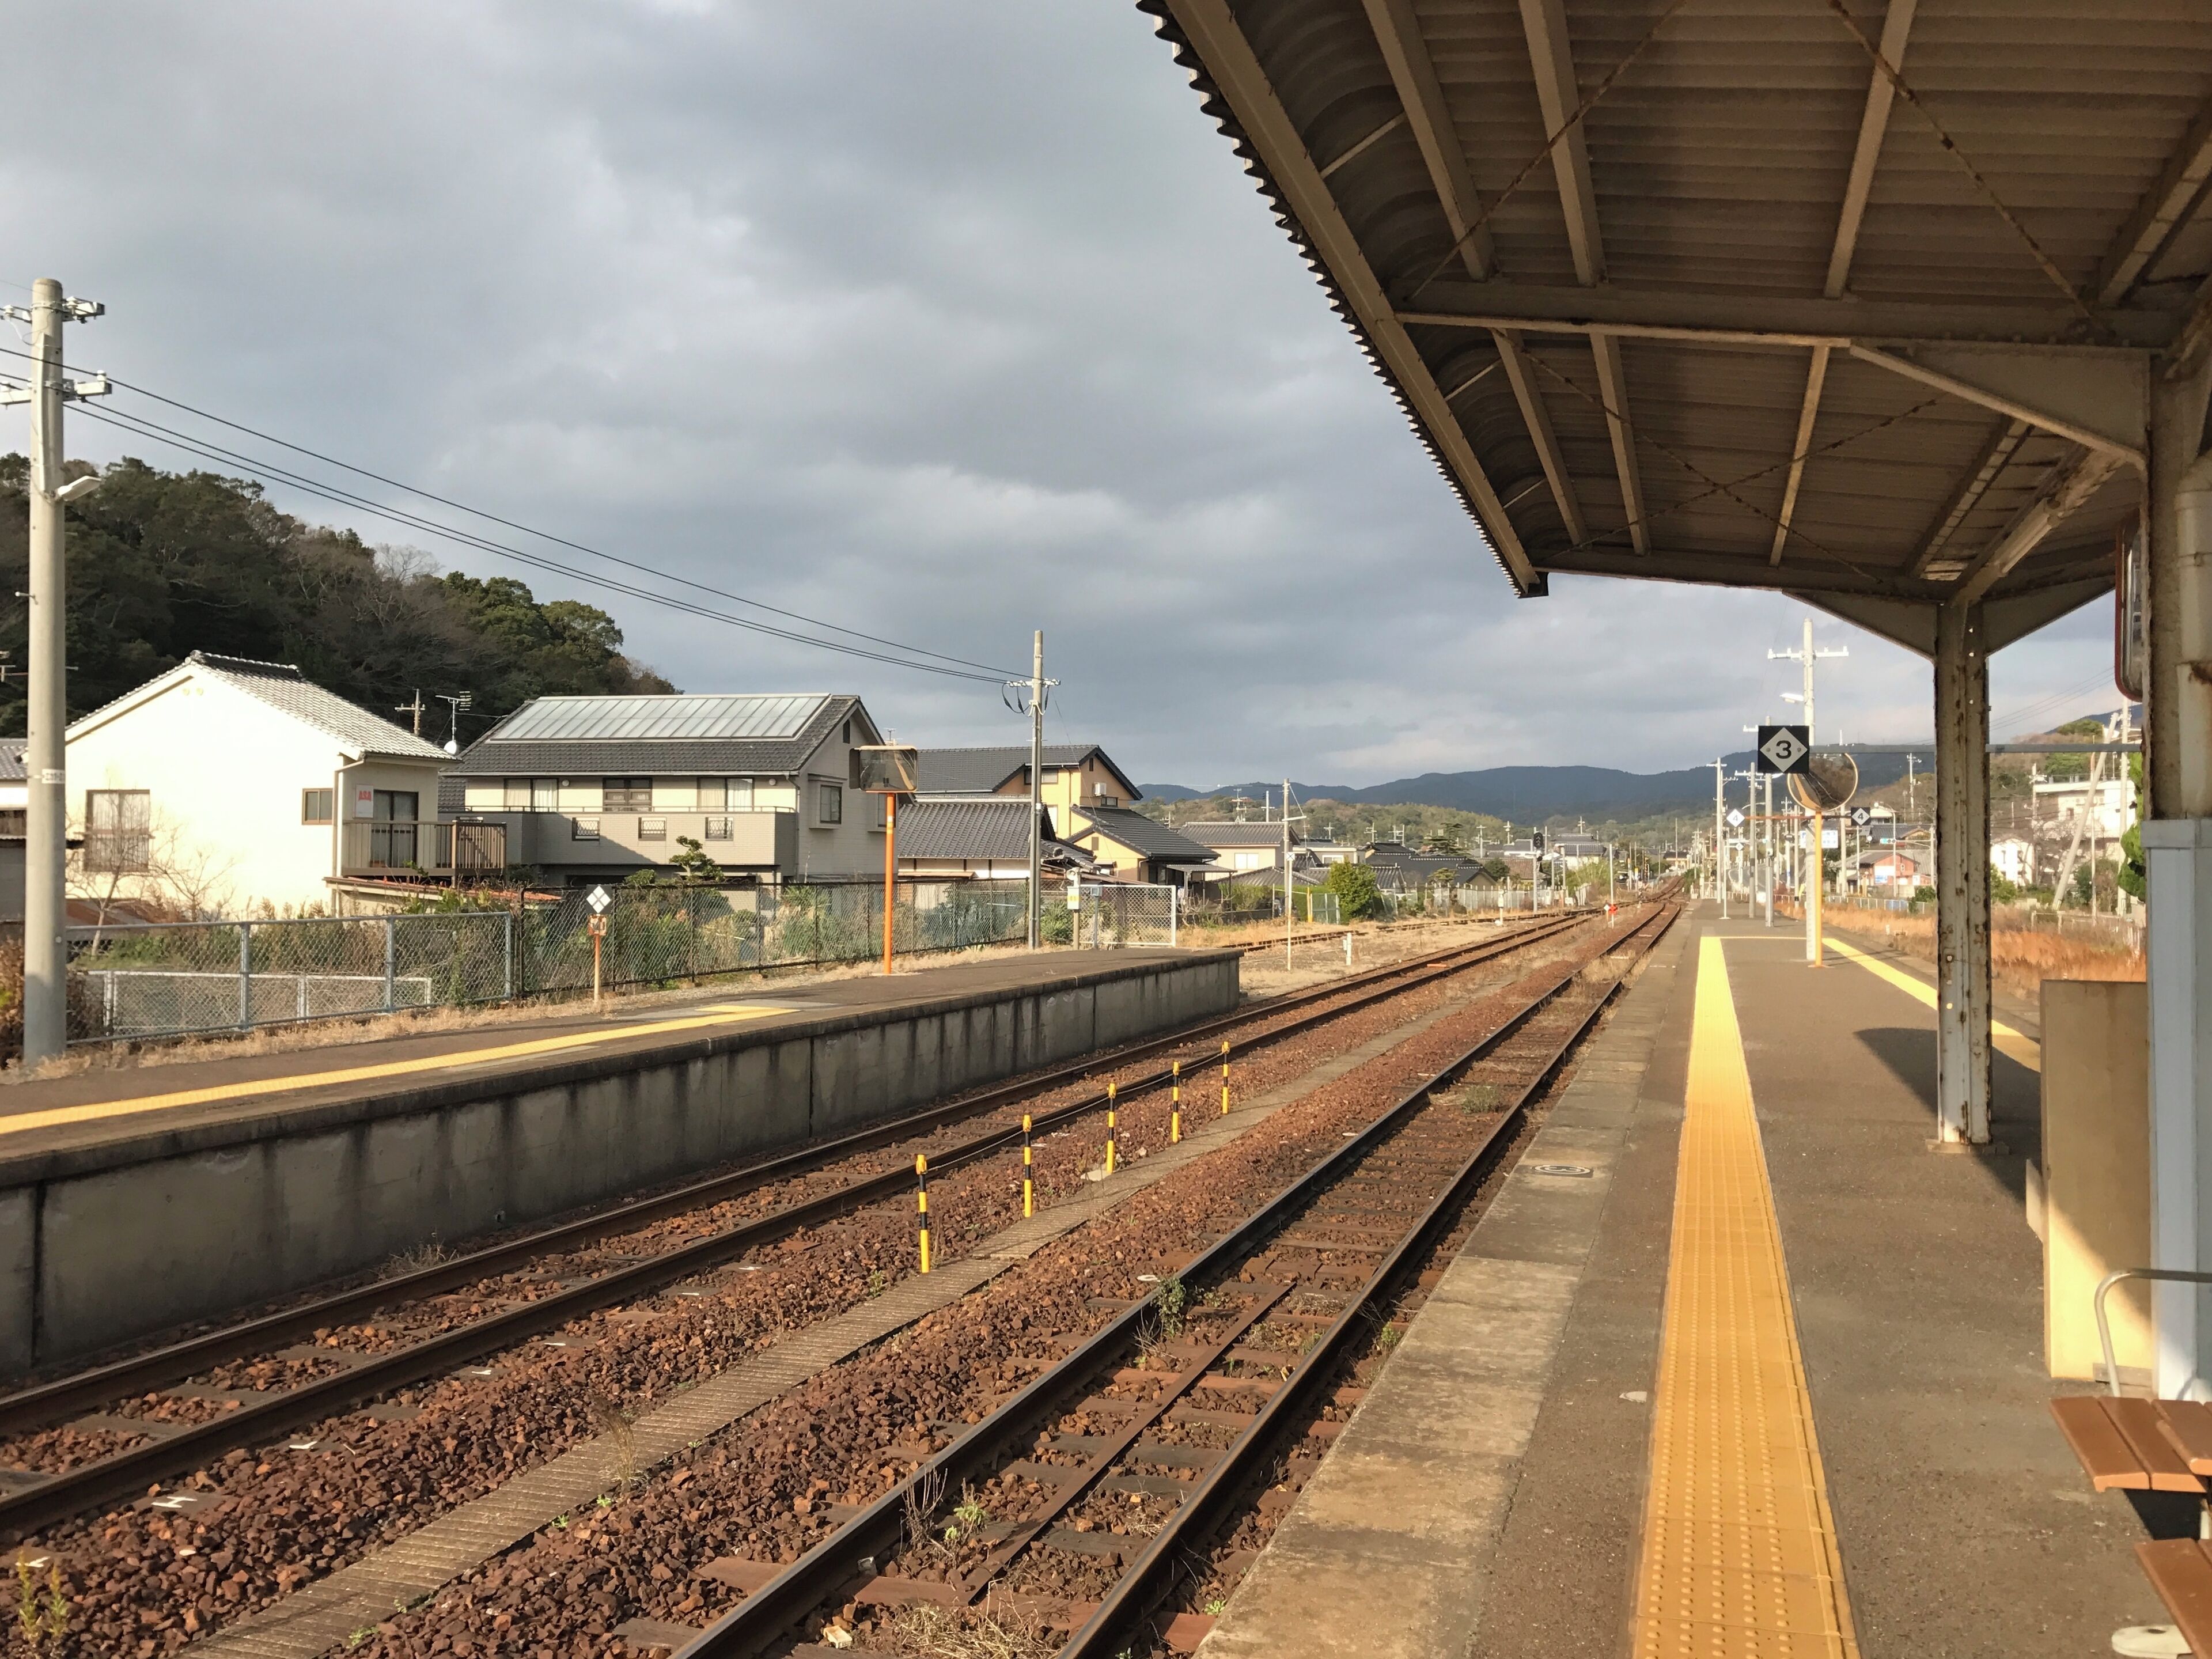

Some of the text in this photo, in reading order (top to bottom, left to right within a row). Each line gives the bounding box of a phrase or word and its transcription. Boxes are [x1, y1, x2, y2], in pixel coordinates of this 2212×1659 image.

[1776, 740, 1791, 759] 3
[358, 790, 372, 802] ASA
[1858, 812, 1863, 820] 4
